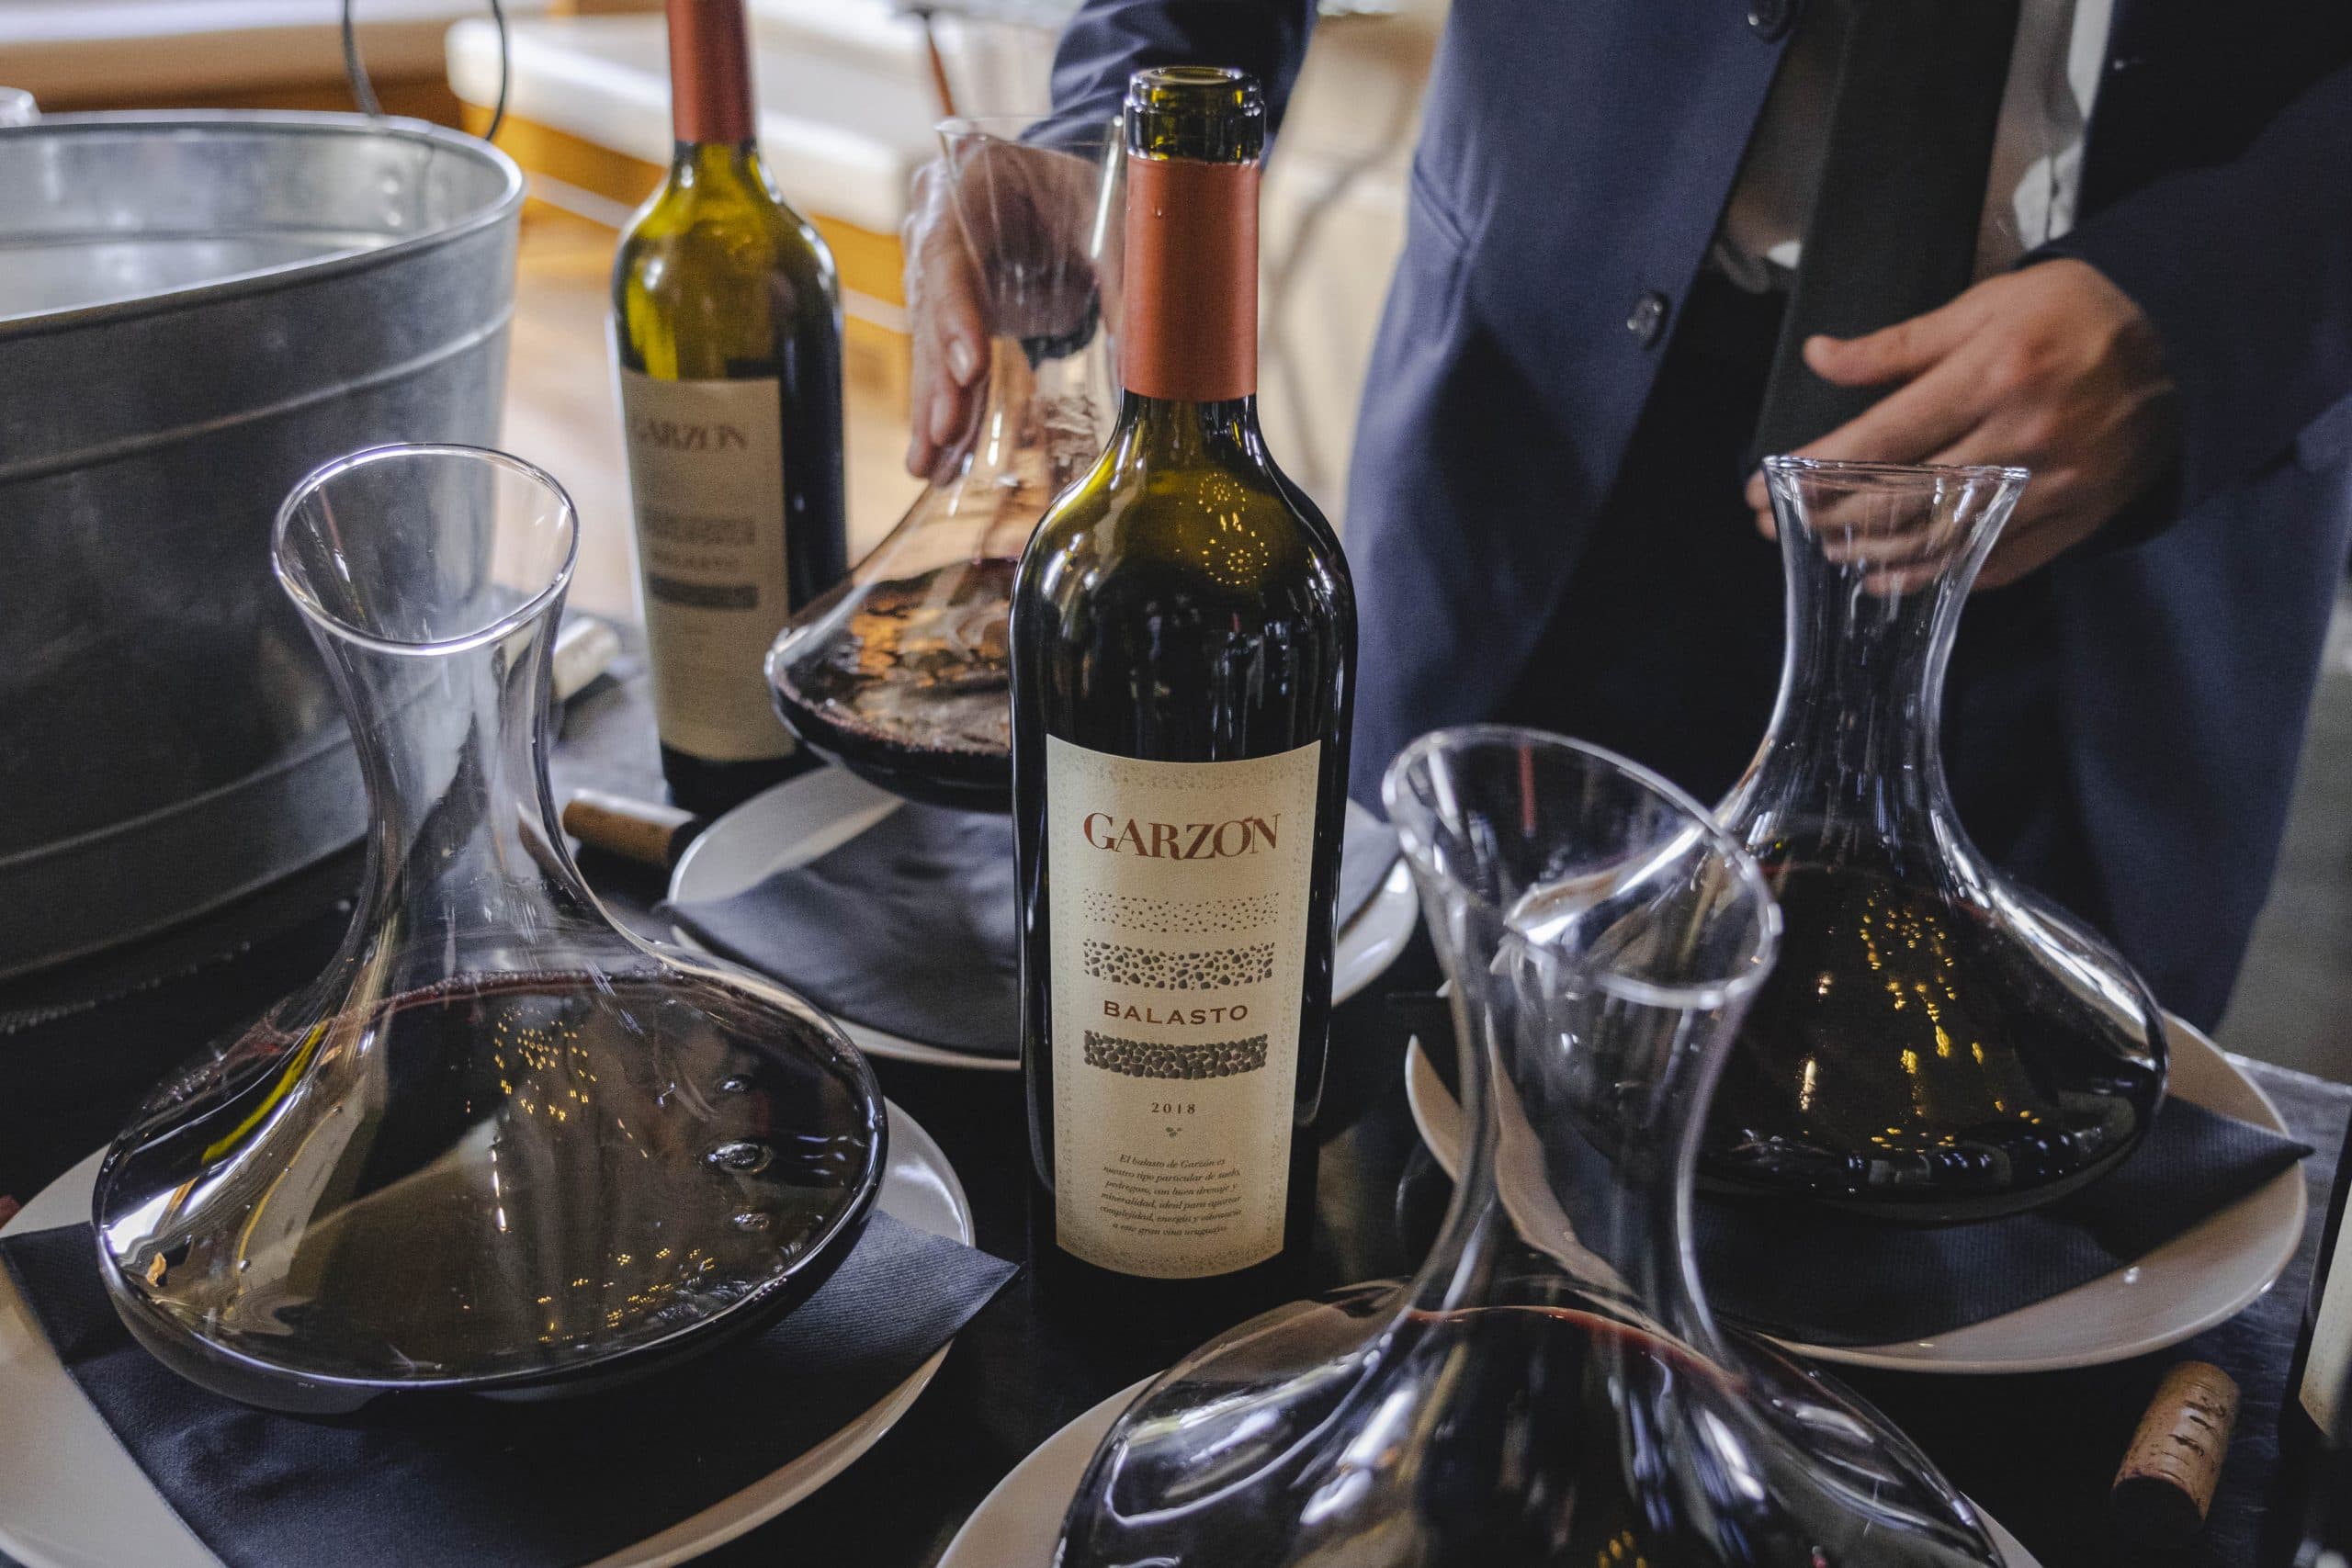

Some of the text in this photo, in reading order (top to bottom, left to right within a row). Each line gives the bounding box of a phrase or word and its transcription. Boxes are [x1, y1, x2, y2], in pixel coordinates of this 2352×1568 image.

[1083, 812, 1281, 861] GARZÓN
[1103, 999, 1248, 1026] BALASTO
[1151, 1101, 1195, 1115] 2018
[1120, 1154, 1131, 1164] El
[1132, 1156, 1165, 1168] balasto
[1166, 1159, 1179, 1168] de
[1102, 1166, 1135, 1178] nuestro
[1136, 1170, 1155, 1182] tipo
[1154, 1173, 1204, 1184] particular
[1204, 1171, 1216, 1180] de
[1104, 1180, 1152, 1195] pedregoso,
[1171, 1186, 1194, 1196] buen
[1101, 1192, 1157, 1209] mineralidad,
[1158, 1200, 1182, 1210] ideal
[1182, 1201, 1207, 1212] para
[1137, 1227, 1161, 1237] gran
